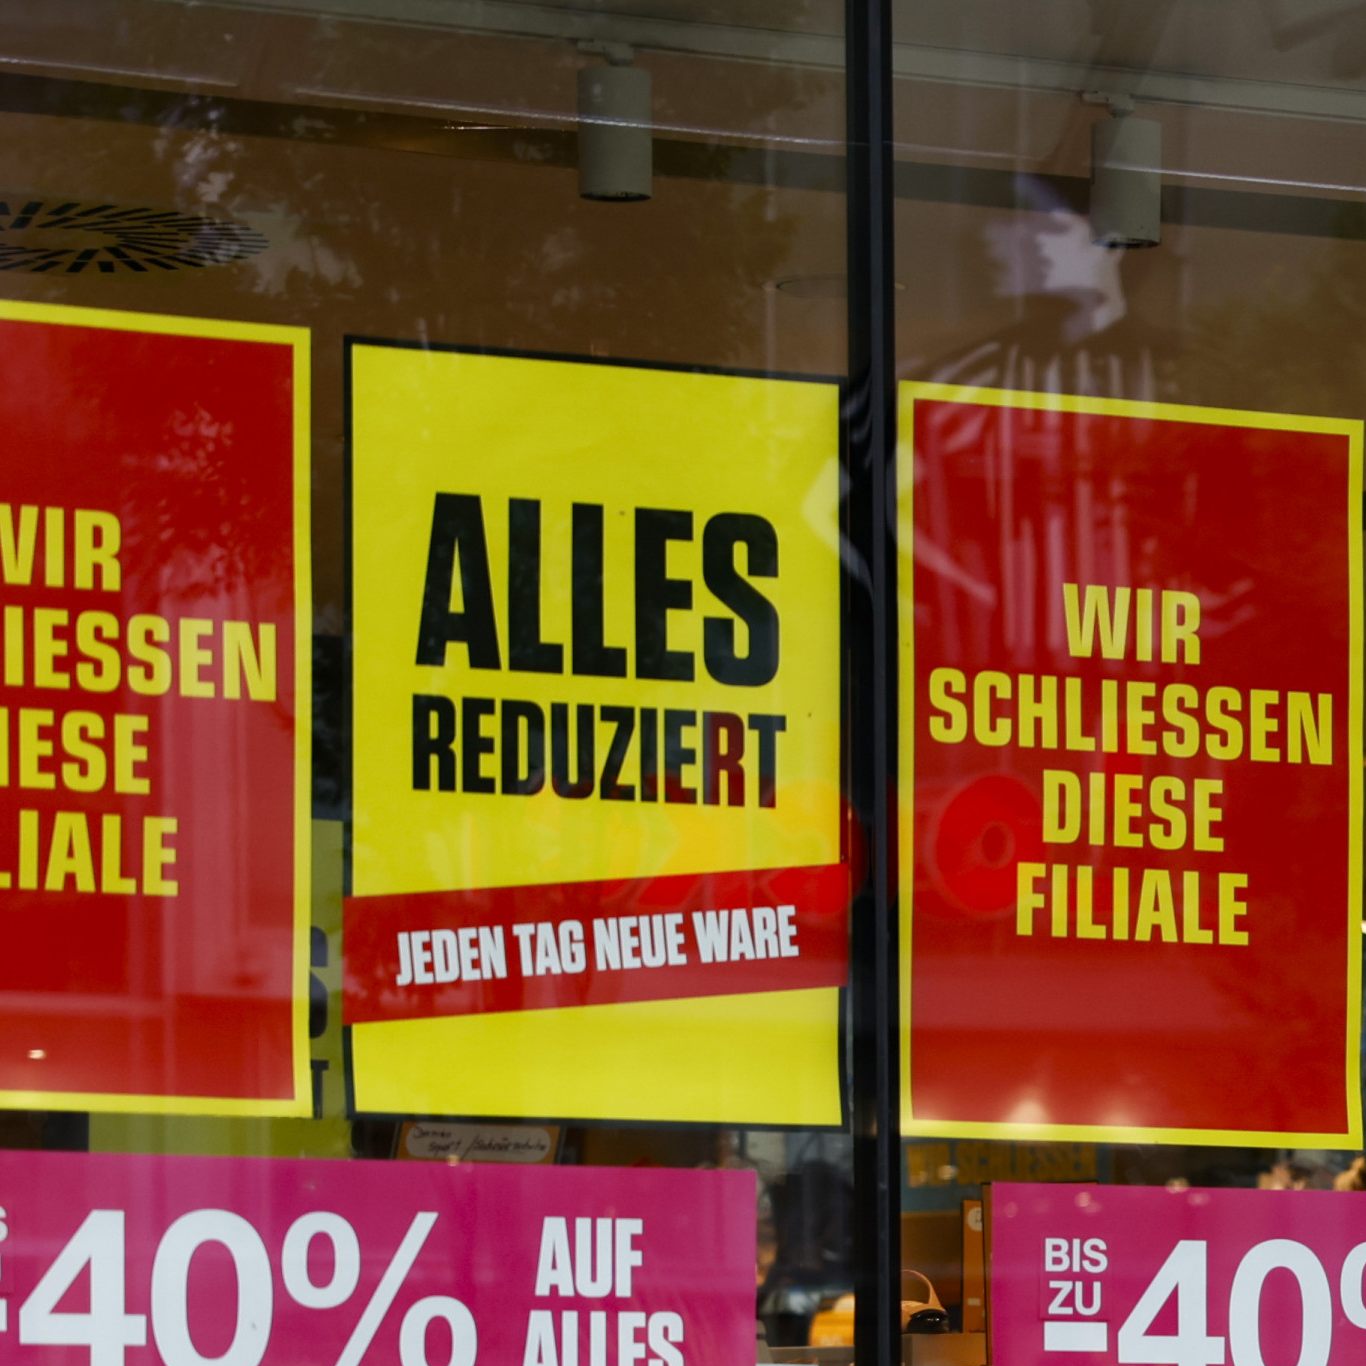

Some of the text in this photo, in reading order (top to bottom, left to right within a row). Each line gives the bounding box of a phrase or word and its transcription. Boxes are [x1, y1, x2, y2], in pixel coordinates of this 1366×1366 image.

[416, 493, 779, 686] ALLES
[1063, 583, 1200, 664] WIR
[413, 694, 786, 808] REDUZIERT
[930, 669, 1332, 764] SCHLIESSEN
[1043, 770, 1223, 851] DIESE
[1017, 863, 1248, 945] FILIALE
[397, 906, 798, 985] JEDEN TAG NEUE WARE
[536, 1217, 642, 1297] AUF
[1046, 1239, 1107, 1272] BIS
[1049, 1281, 1100, 1315] ZU
